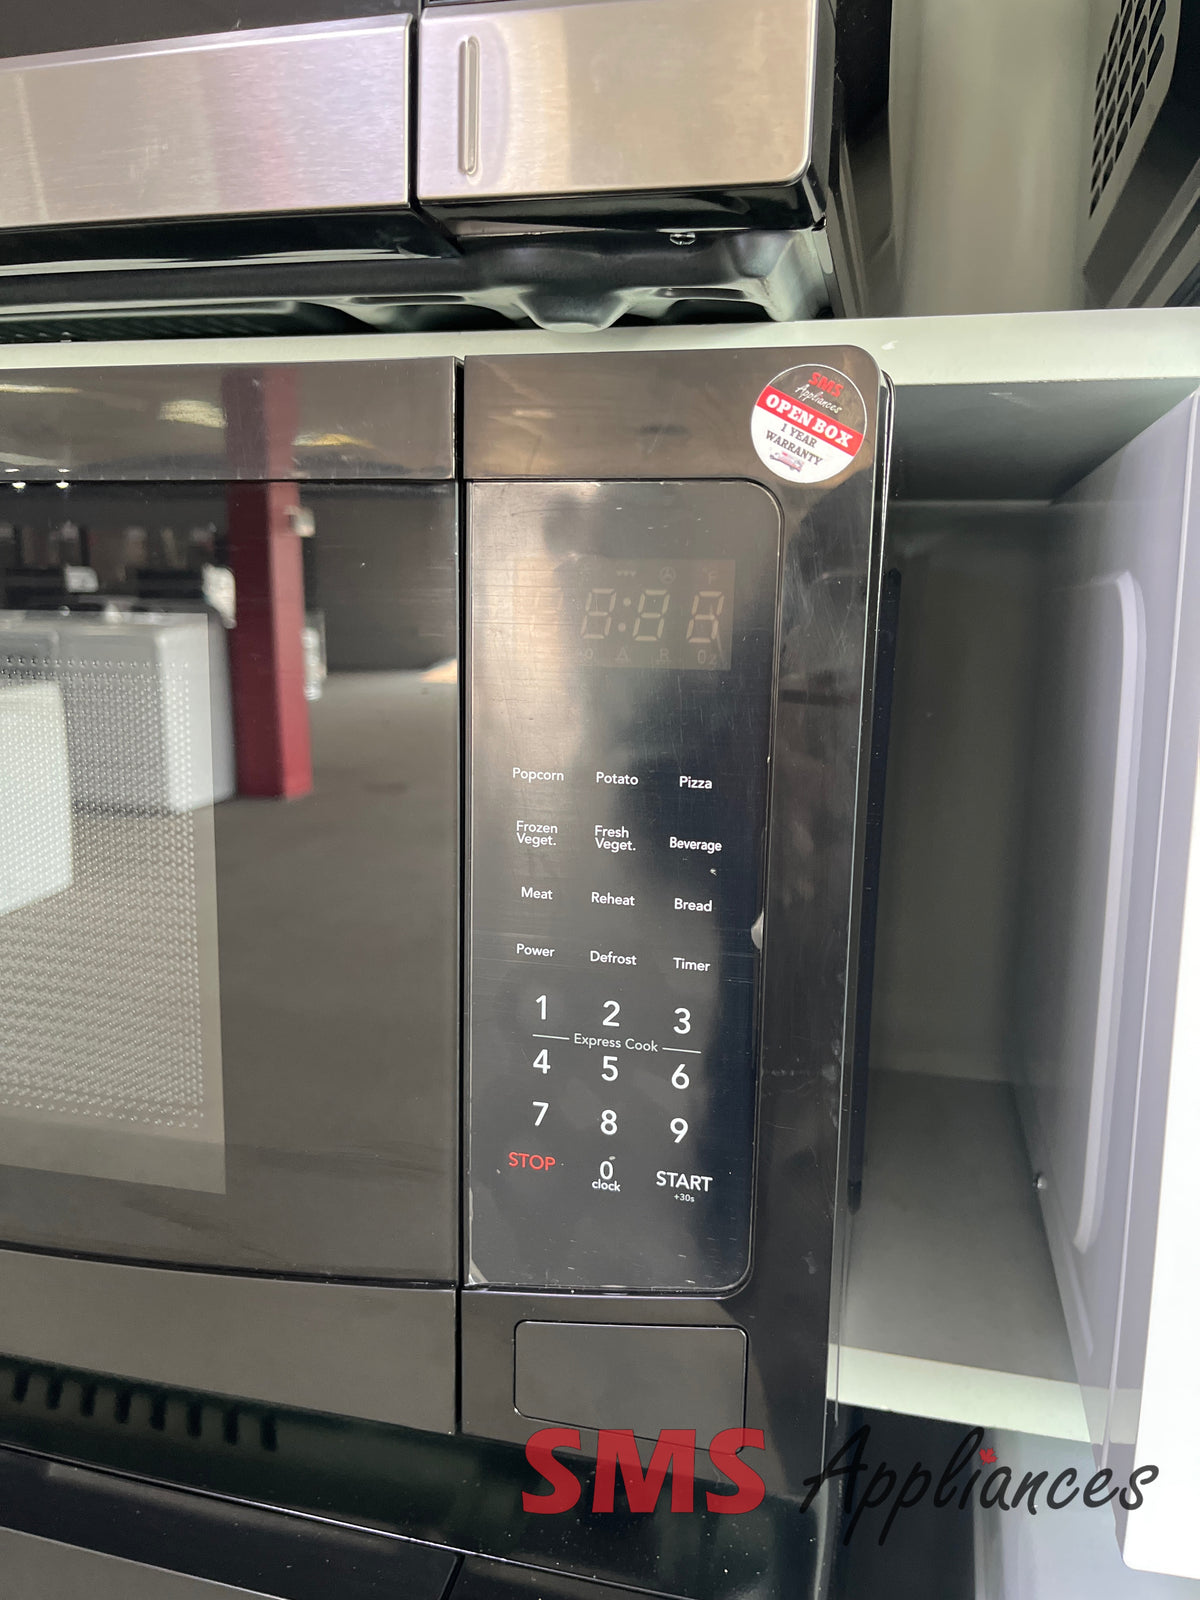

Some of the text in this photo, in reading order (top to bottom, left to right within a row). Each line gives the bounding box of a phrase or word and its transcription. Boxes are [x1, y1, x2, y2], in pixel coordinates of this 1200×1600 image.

[808, 372, 844, 398] SMS
[795, 383, 843, 414] Appliances
[765, 394, 853, 448] OPEN BOX
[765, 430, 824, 466] WARRANTY
[789, 427, 818, 449] YEAR
[512, 767, 565, 783] Popcorn
[595, 771, 639, 786] Potato
[679, 775, 713, 790] Pizza
[516, 820, 558, 834] Frozen
[594, 825, 630, 839] Fresh
[516, 832, 557, 848] Veget.
[595, 837, 637, 853] Veget.
[669, 836, 723, 854] Beverage
[521, 886, 553, 900] Meat
[591, 892, 636, 906] Reheat
[674, 898, 713, 912] Bread
[516, 943, 555, 957] Power
[589, 950, 637, 966] Defrost
[672, 957, 711, 972] Timer
[535, 994, 548, 1021] 1
[602, 1000, 621, 1027] 2
[673, 1007, 692, 1035] 3
[573, 1032, 659, 1052] Express Cook
[532, 1048, 551, 1075] 4
[601, 1055, 619, 1082] 5
[671, 1063, 690, 1090] 6
[532, 1101, 549, 1127] 7
[600, 1109, 618, 1136] 8
[669, 1117, 689, 1144] 9
[508, 1151, 556, 1171] STOP
[599, 1160, 614, 1181] 0
[591, 1179, 621, 1193] clock
[656, 1170, 713, 1192] START
[673, 1193, 695, 1203] +30s
